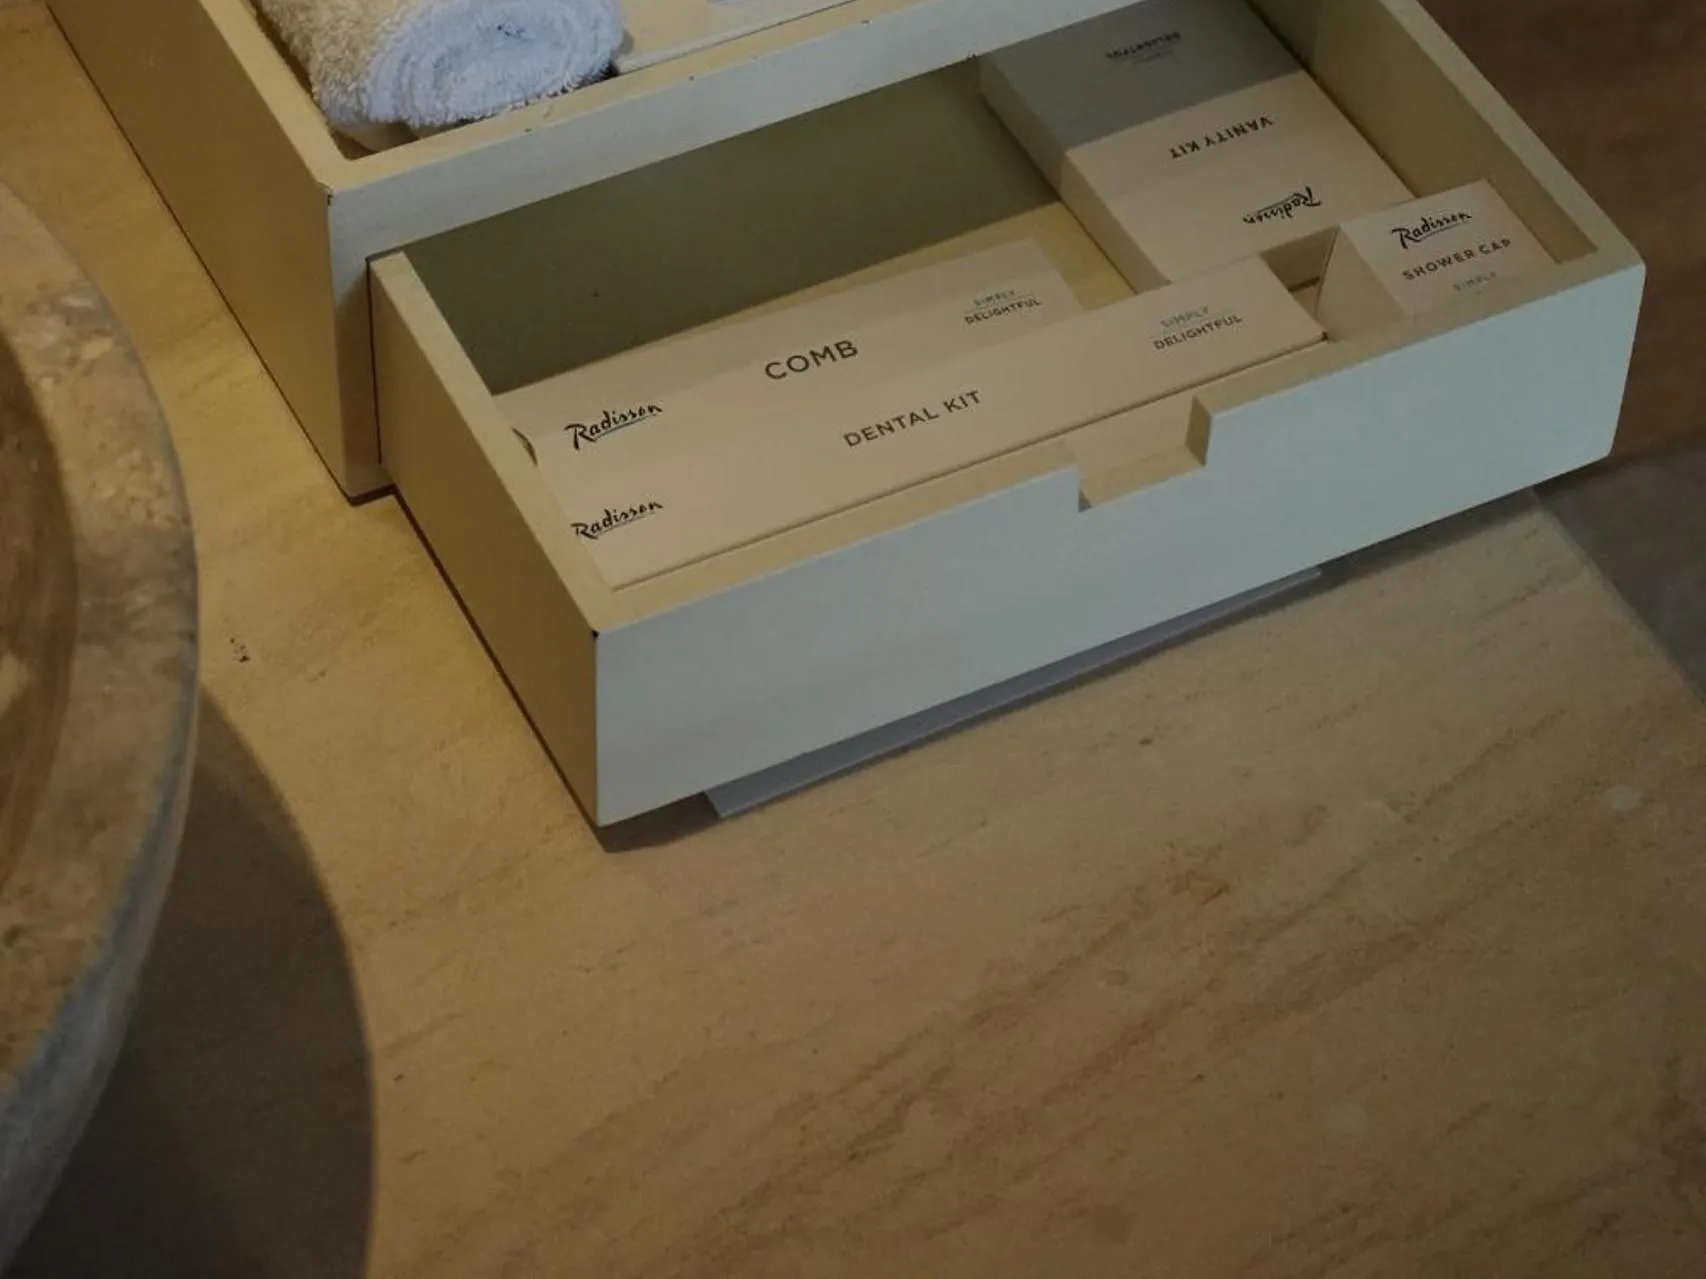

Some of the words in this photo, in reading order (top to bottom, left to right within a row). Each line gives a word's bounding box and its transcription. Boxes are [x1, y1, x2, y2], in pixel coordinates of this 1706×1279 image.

[1168, 138, 1201, 160] KIT
[1203, 116, 1274, 148] VANITY
[1242, 185, 1322, 225] Radisson
[1391, 211, 1473, 250] Radisson
[1402, 248, 1475, 281] SHOWER
[1477, 237, 1512, 256] CAP
[964, 297, 1043, 325] DELIGHTFUL
[1153, 313, 1244, 351] DELIGHTFUL
[764, 339, 858, 381] COMB
[564, 401, 664, 452] Radisson
[842, 406, 940, 448] DENTAL
[942, 389, 983, 415] KIT
[571, 497, 664, 541] Radisson
